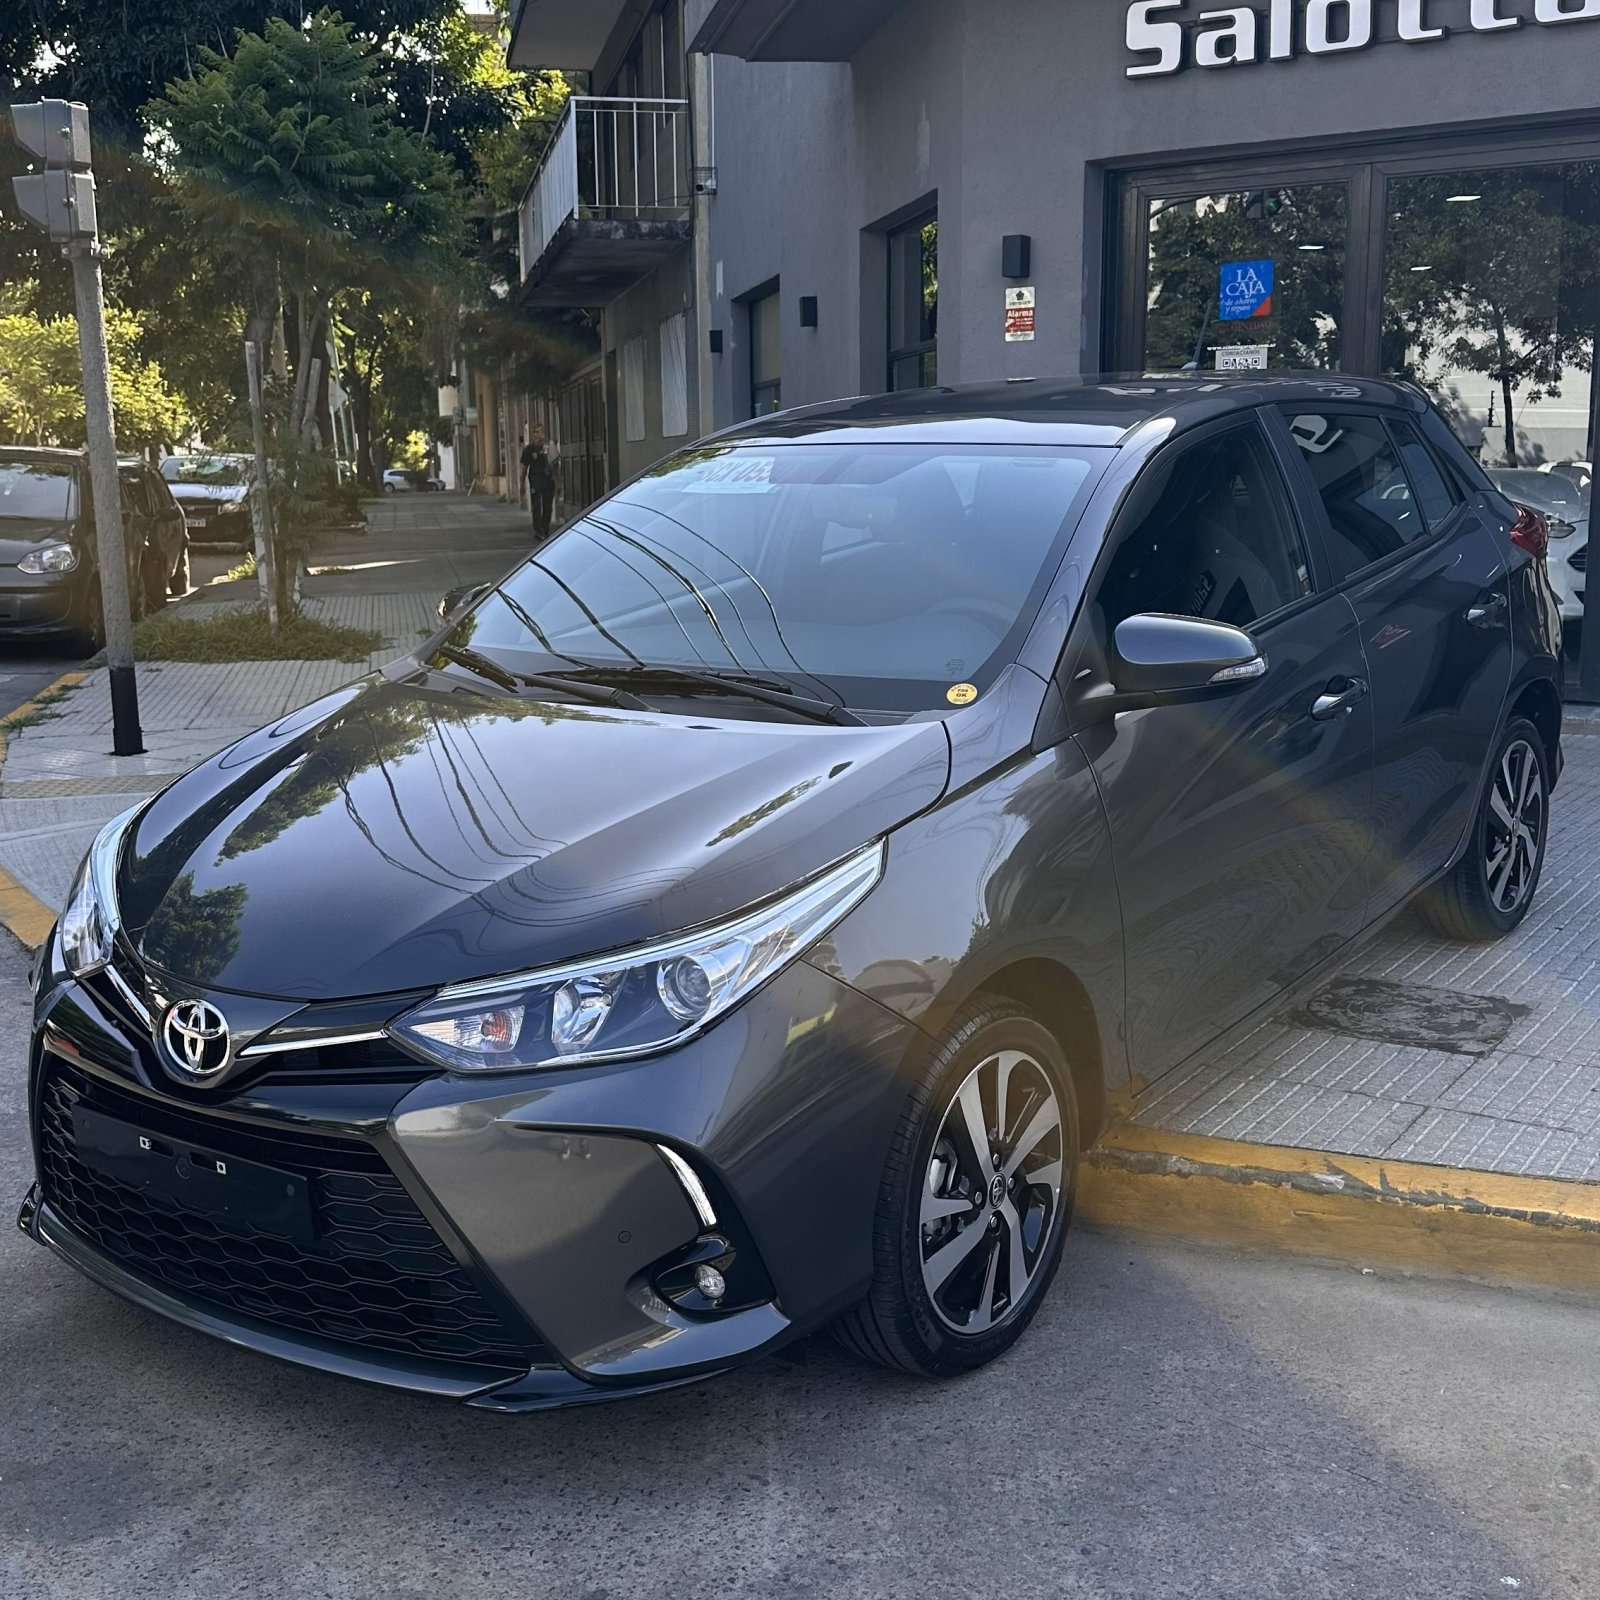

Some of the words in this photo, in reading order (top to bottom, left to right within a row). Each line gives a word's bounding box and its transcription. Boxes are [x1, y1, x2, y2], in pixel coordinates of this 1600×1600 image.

[1236, 268, 1258, 283] LA
[1225, 280, 1266, 298] CAJA
[1007, 309, 1033, 318] Alarma
